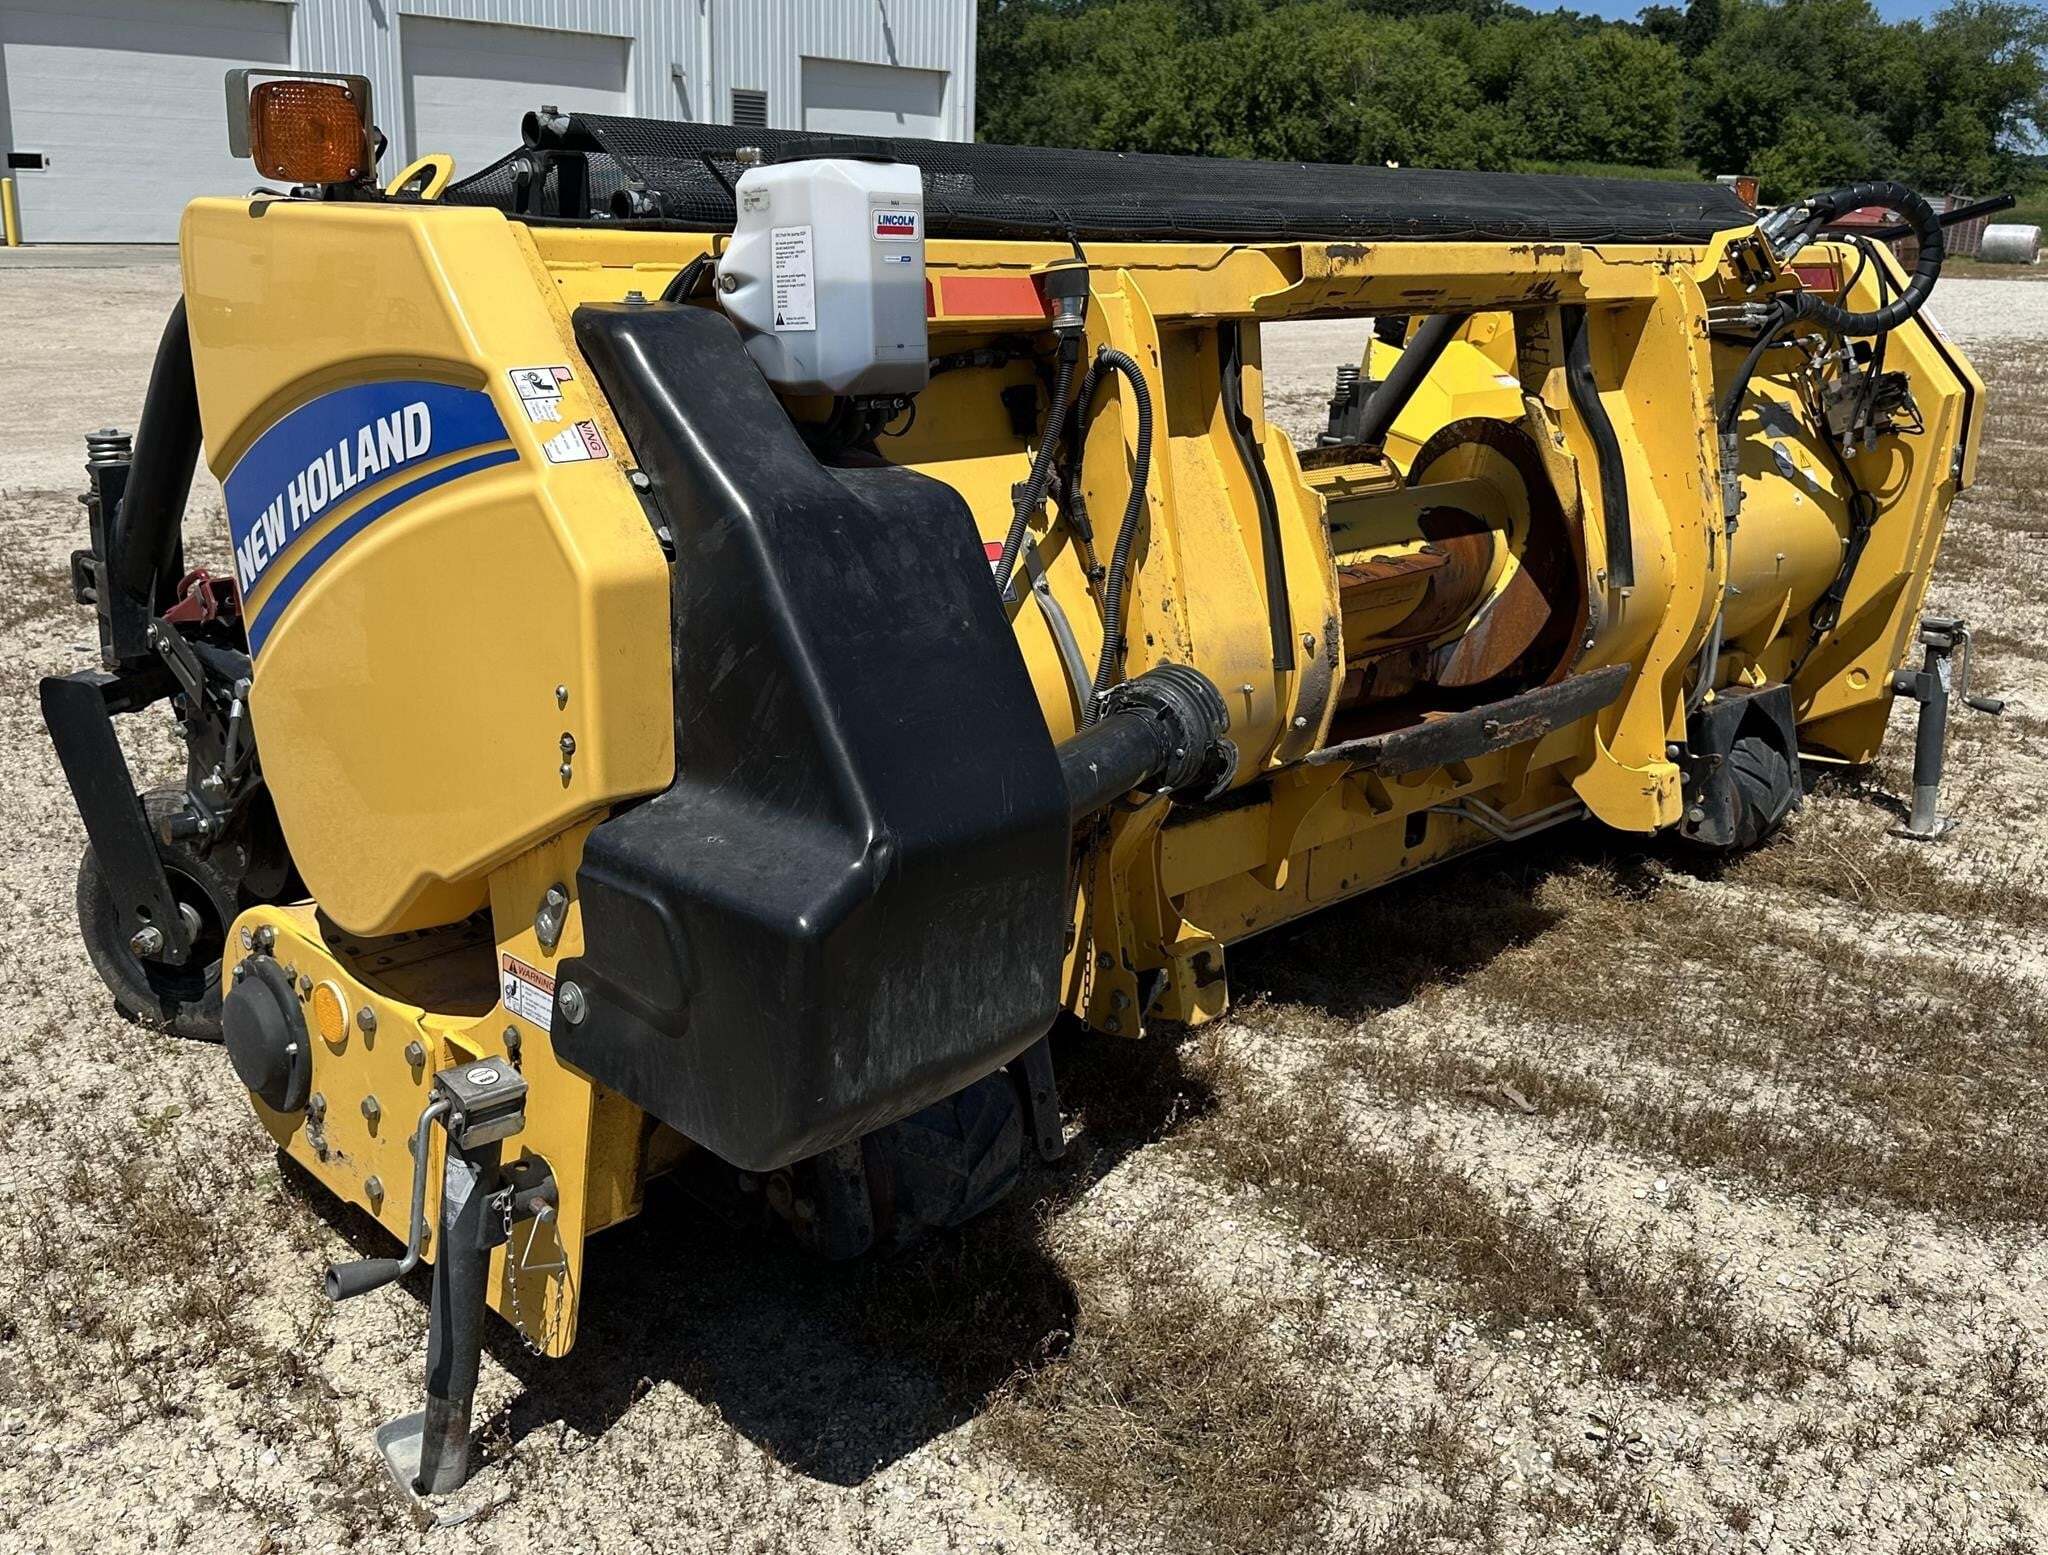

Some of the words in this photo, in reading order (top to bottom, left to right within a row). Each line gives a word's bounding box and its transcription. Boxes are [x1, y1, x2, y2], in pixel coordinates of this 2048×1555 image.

[878, 215, 914, 225] LINCOLN
[236, 494, 287, 593] NEW
[287, 401, 432, 531] HOLLAND
[518, 965, 555, 991] WARNING
